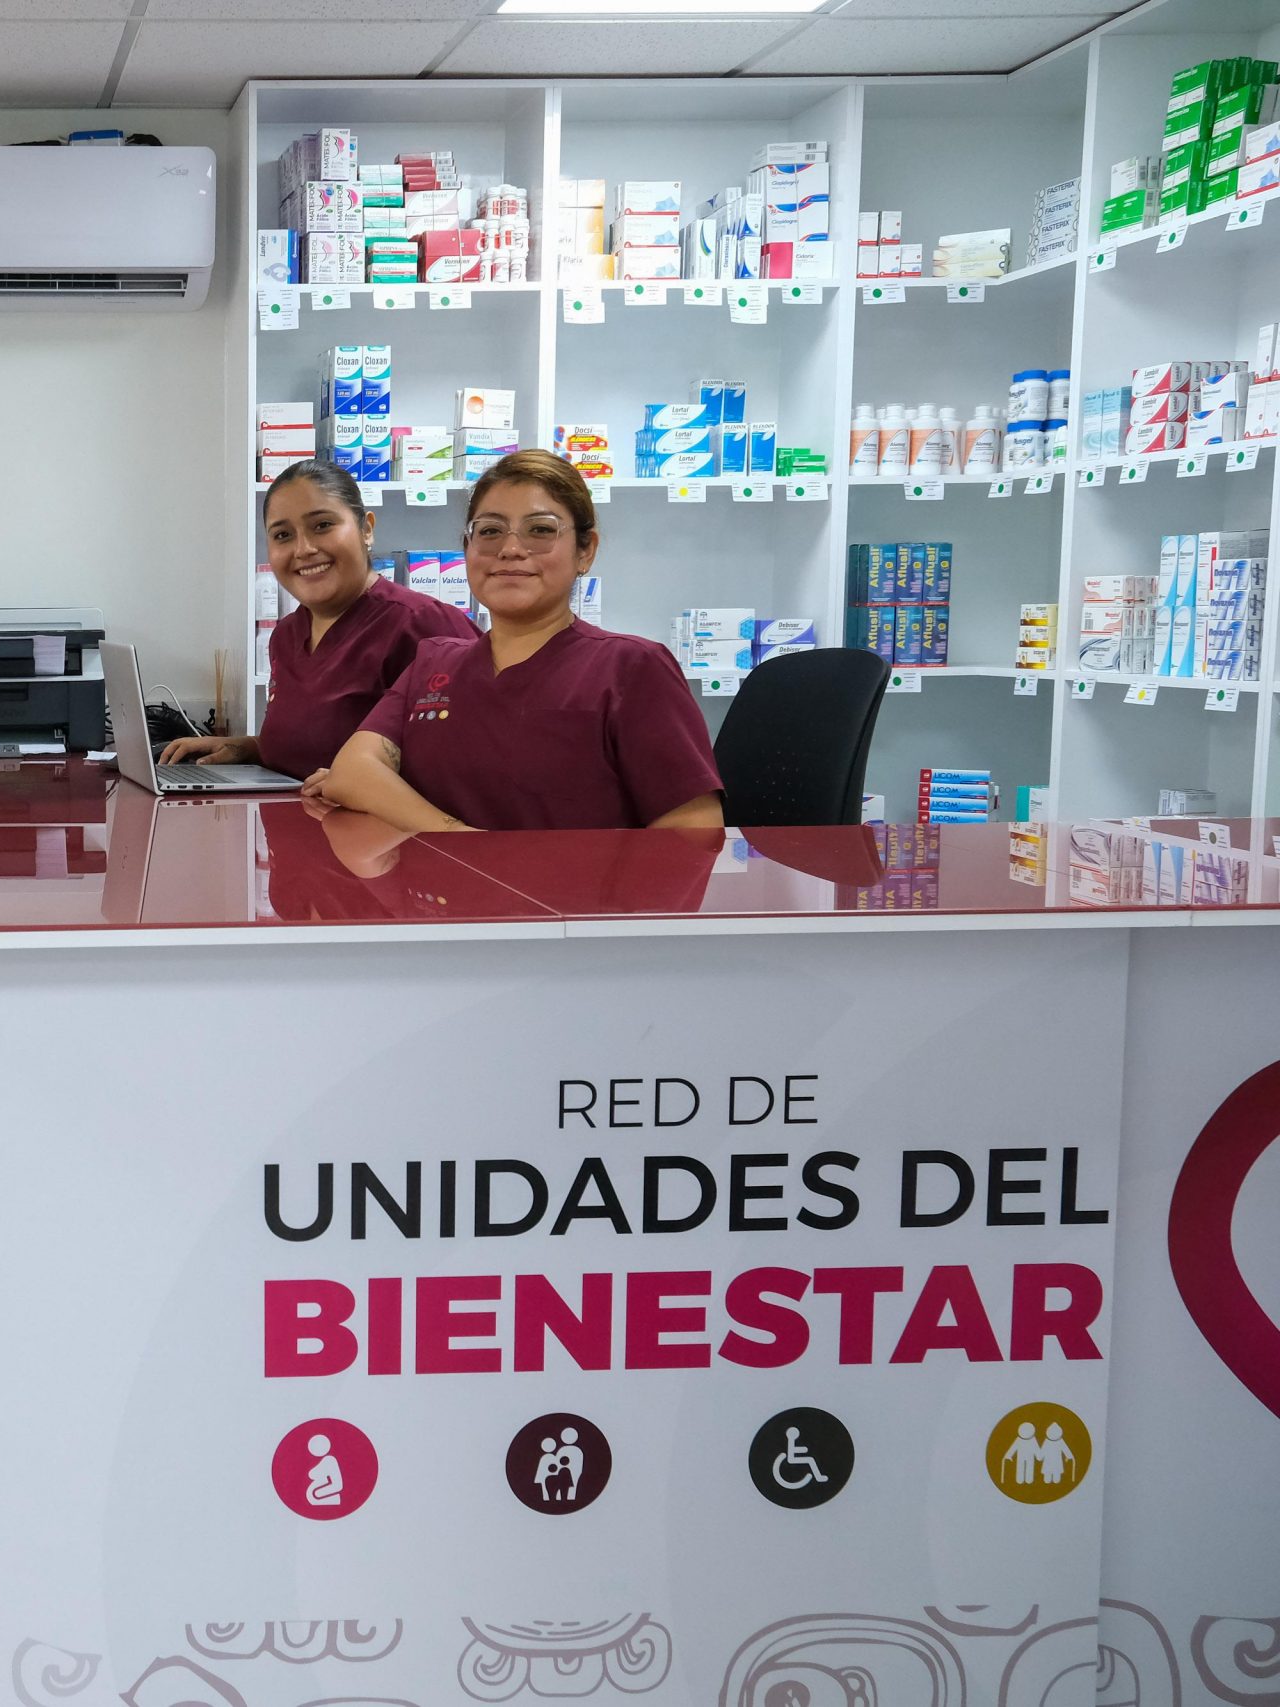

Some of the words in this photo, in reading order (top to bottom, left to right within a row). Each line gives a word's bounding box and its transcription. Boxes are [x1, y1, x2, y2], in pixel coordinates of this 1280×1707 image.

[336, 356, 359, 366] Cloxan
[365, 356, 388, 365] Cloxan
[336, 424, 359, 434] Cloxan
[365, 424, 388, 433] Cloxan
[558, 1077, 699, 1129] RED
[729, 1074, 819, 1125] DE
[264, 1151, 861, 1242] UNIDADES
[900, 1147, 1109, 1228] DEL
[264, 1262, 1104, 1379] BIENESTAR
